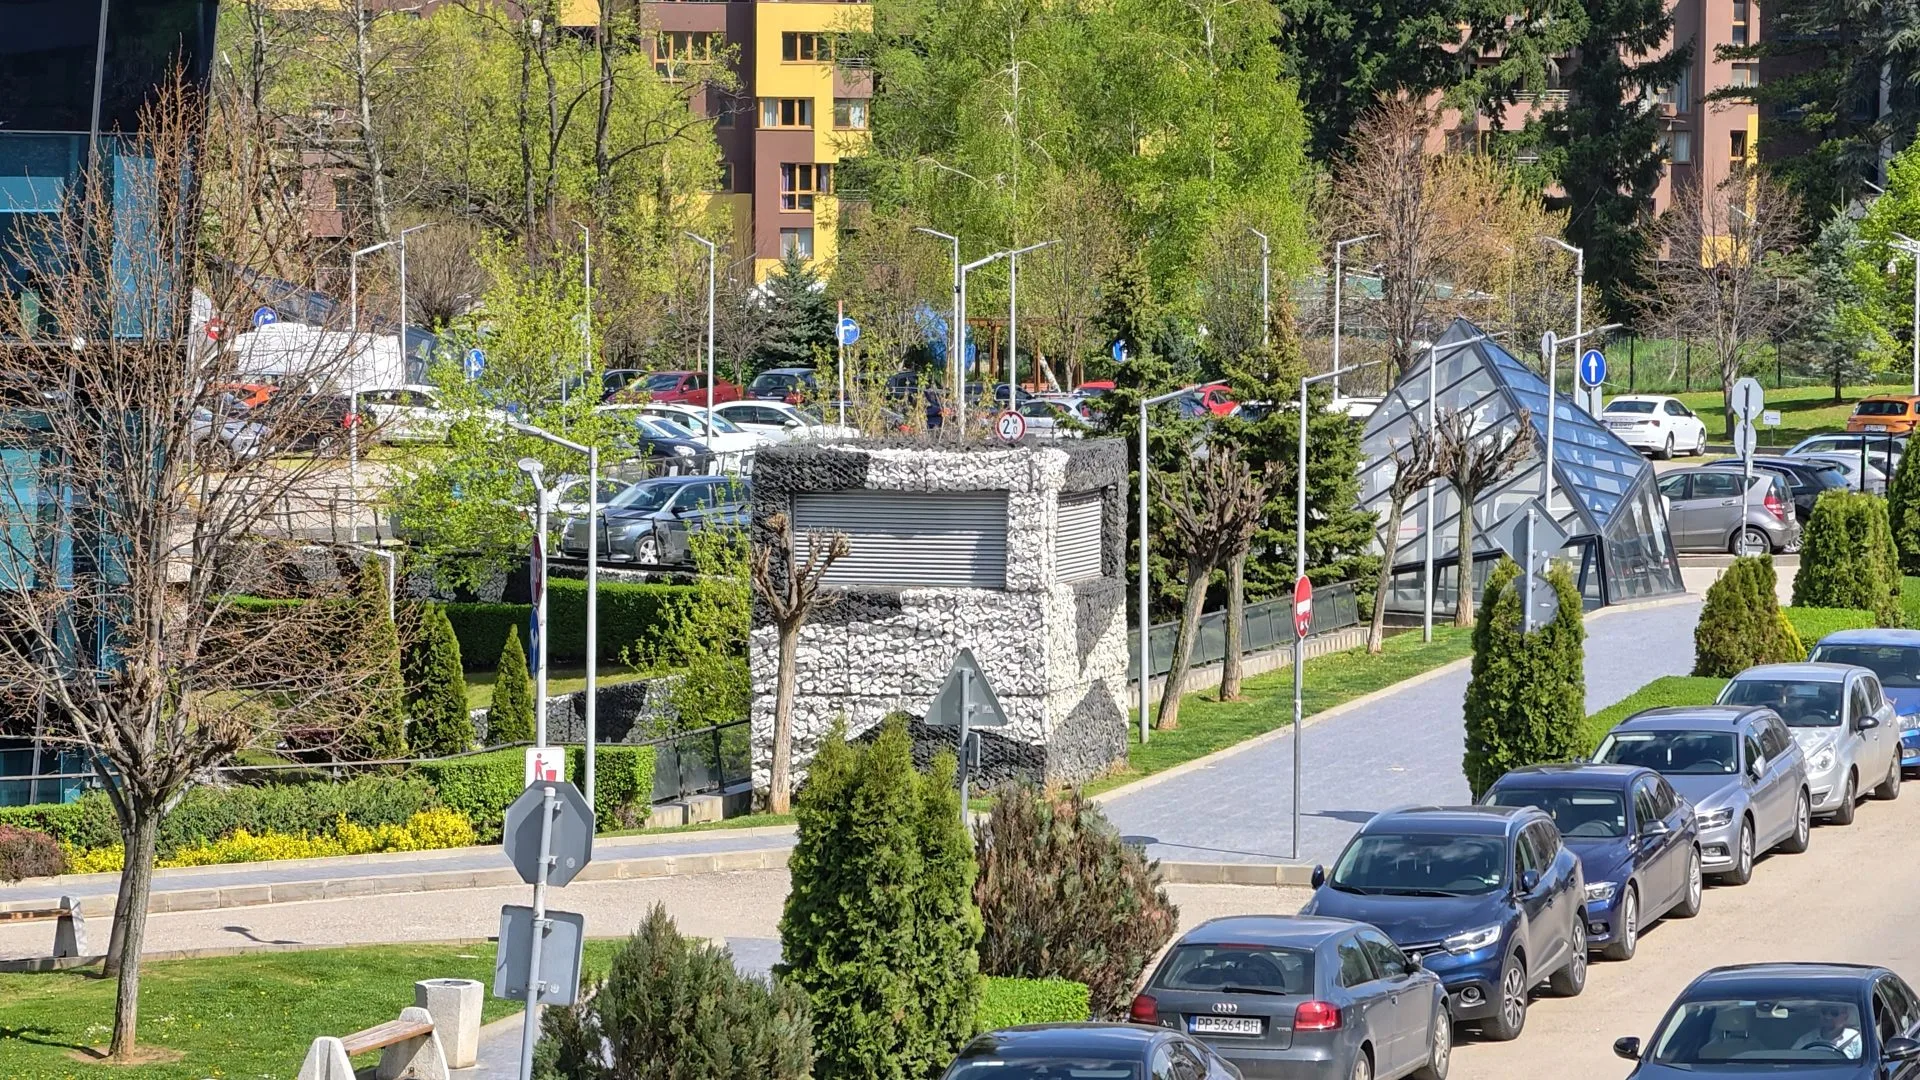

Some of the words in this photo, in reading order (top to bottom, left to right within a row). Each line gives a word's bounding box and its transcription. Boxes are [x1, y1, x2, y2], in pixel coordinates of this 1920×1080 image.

[1197, 1017, 1213, 1030] PP
[1213, 1018, 1241, 1032] 5264
[1243, 1020, 1259, 1033] BH
